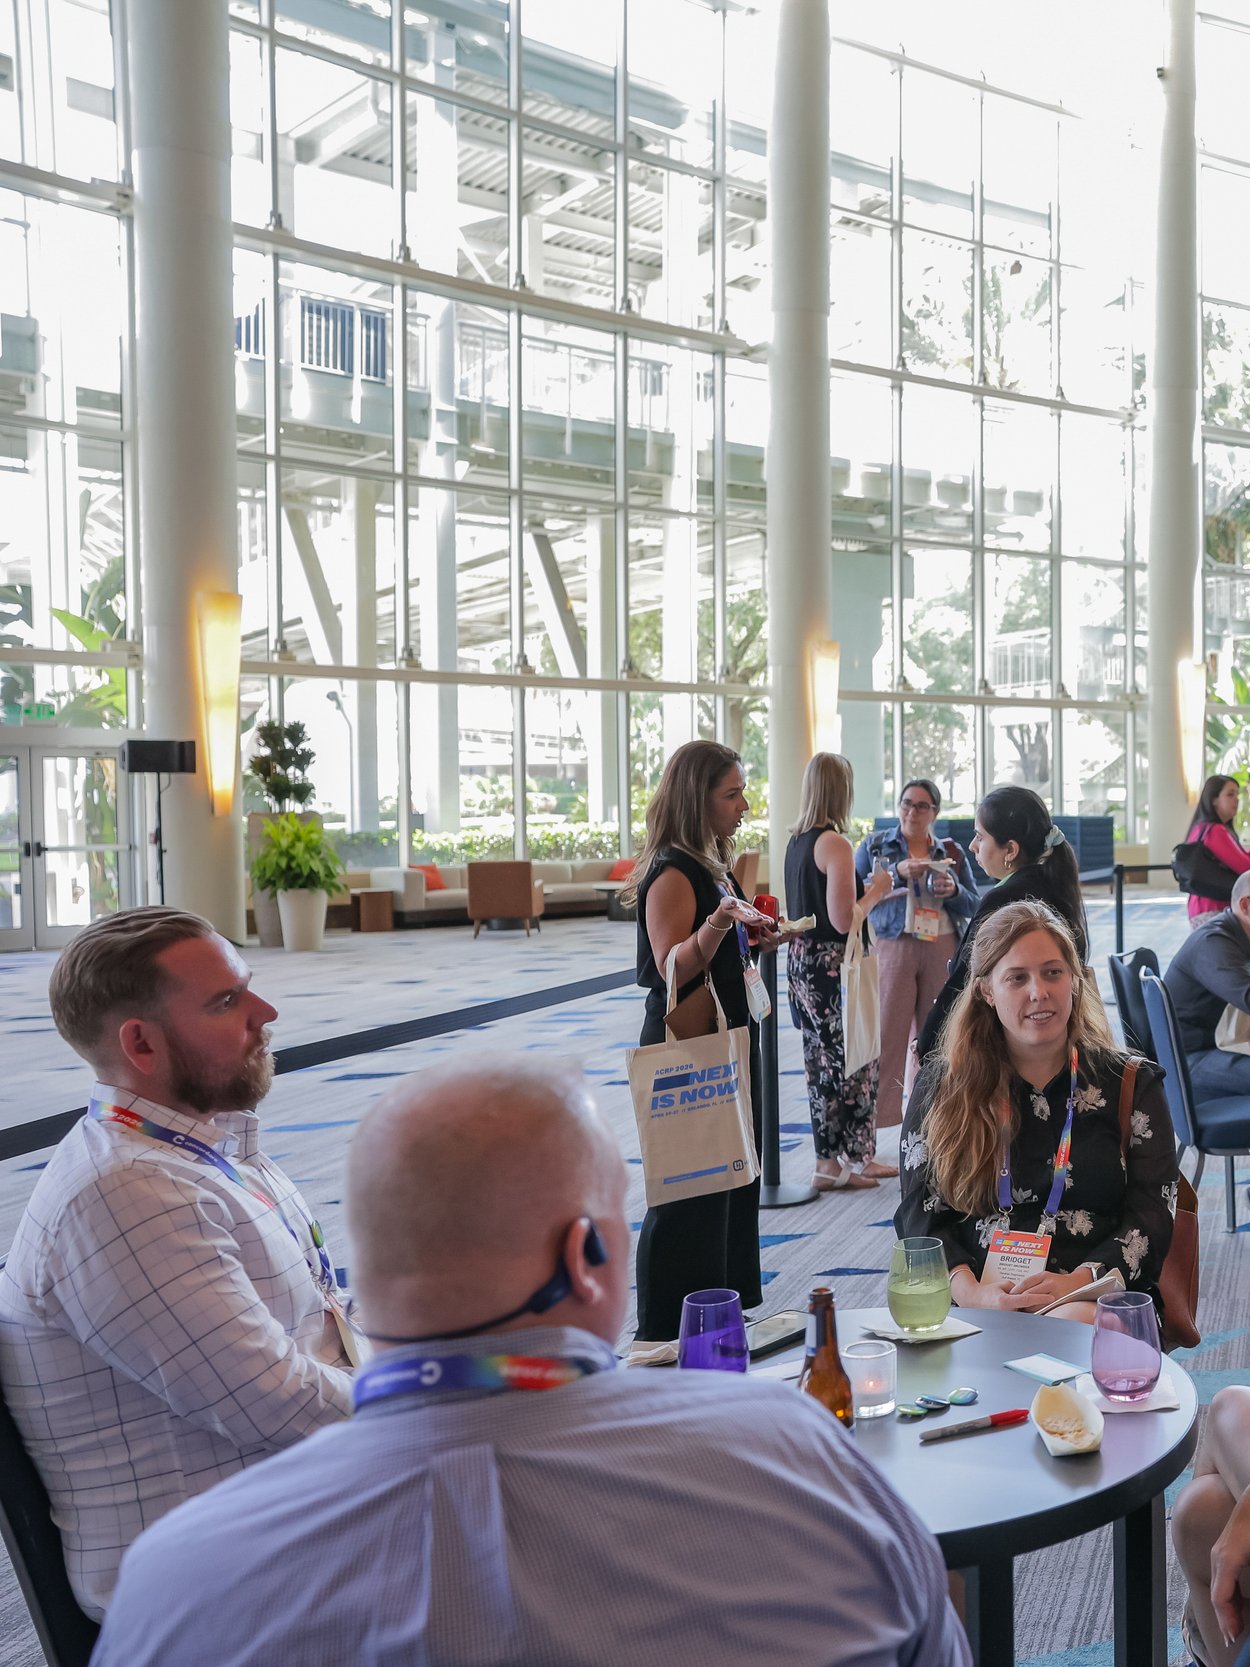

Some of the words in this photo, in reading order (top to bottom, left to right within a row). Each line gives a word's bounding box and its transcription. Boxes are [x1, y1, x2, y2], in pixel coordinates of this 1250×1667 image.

[655, 1066, 675, 1076] ACRP
[675, 1063, 693, 1072] 2026
[689, 1061, 738, 1084] NEXT
[651, 1093, 676, 1111] IS
[1017, 1241, 1043, 1249] NEXT
[1000, 1255, 1032, 1264] BRIDGET
